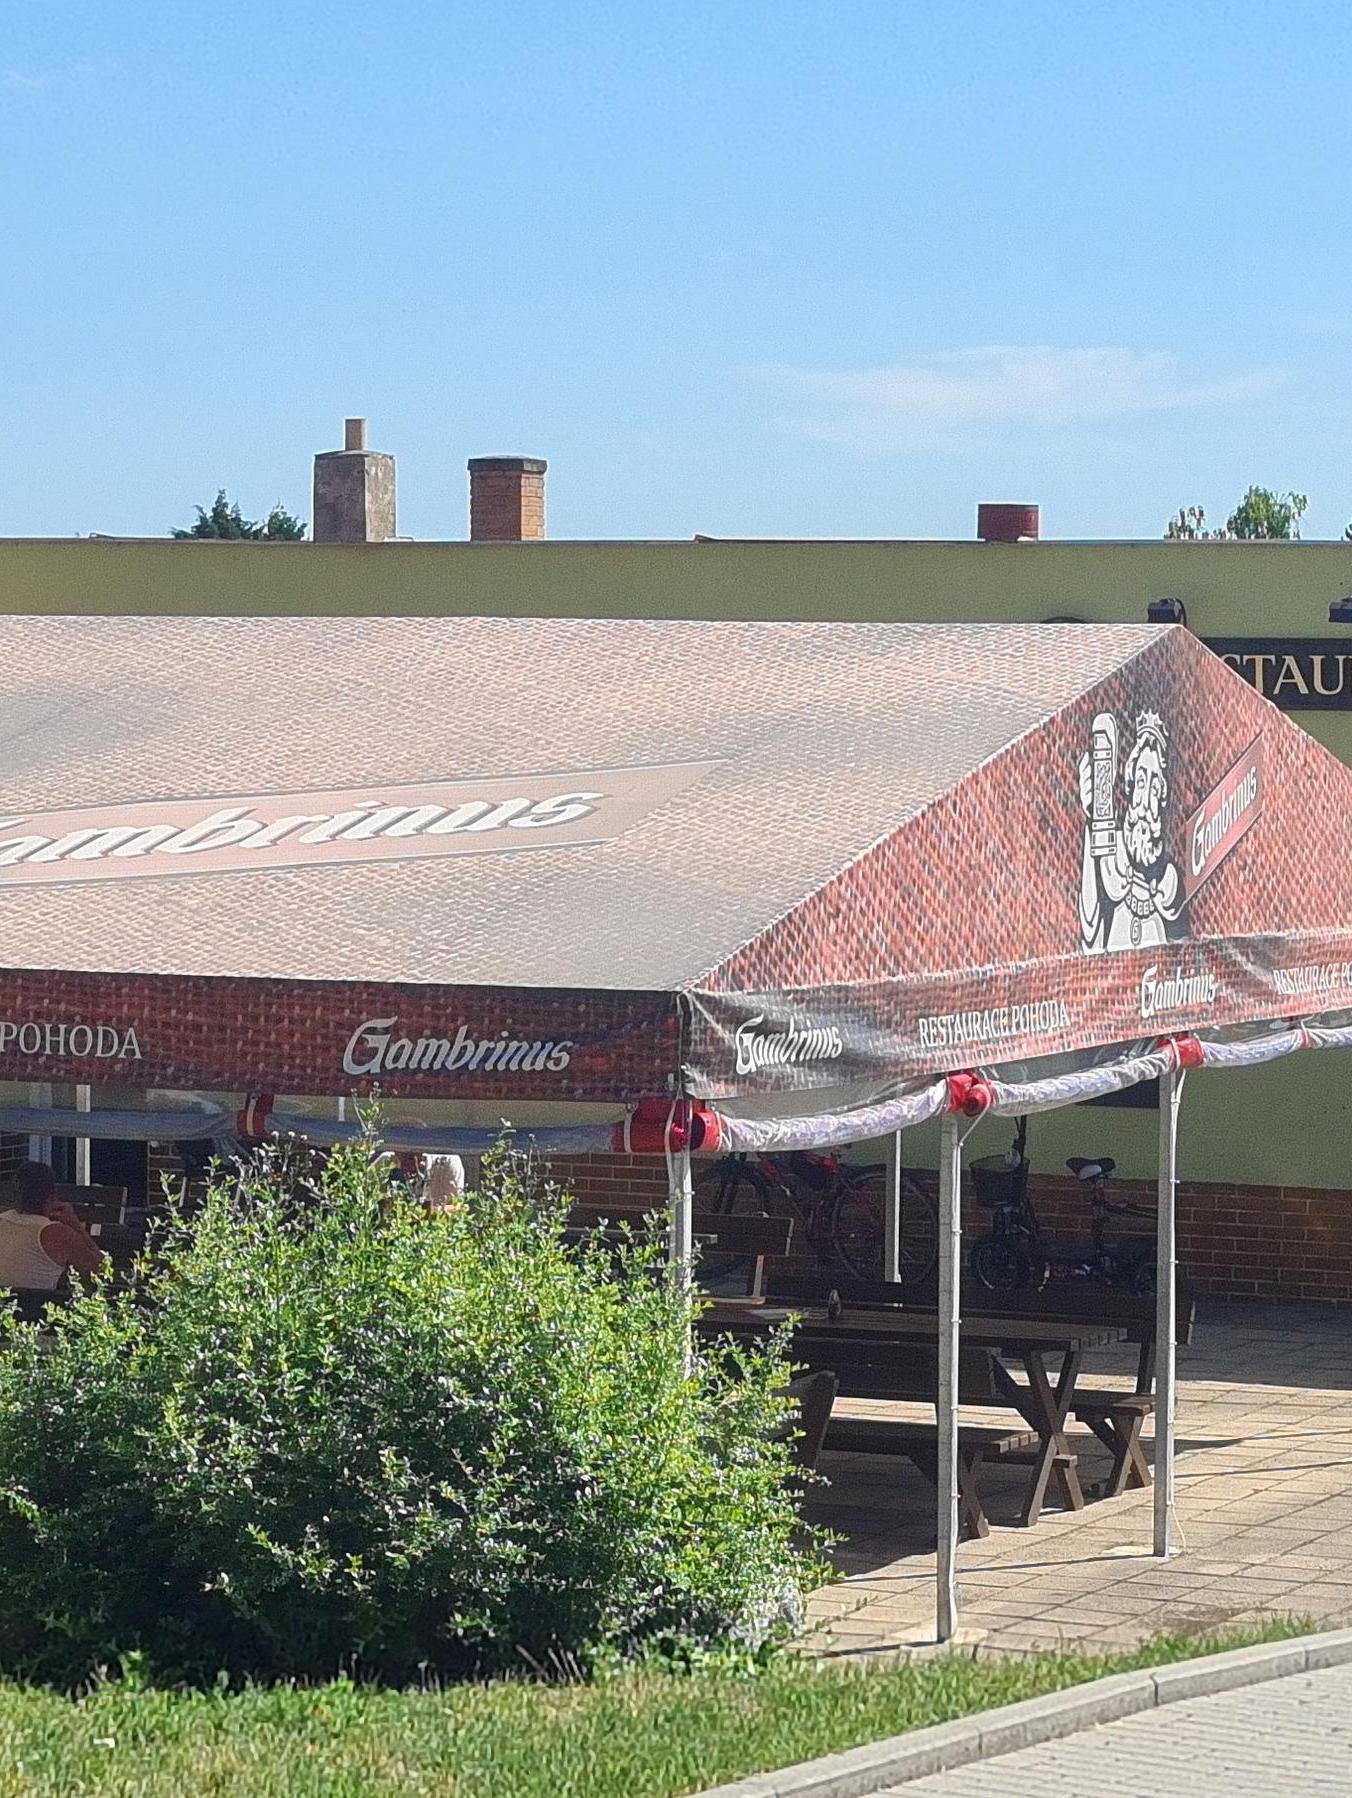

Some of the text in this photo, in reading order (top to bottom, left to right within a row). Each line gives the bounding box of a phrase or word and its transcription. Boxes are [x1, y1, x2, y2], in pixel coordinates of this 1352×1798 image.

[0, 791, 608, 867] ambrinus
[1191, 766, 1257, 876] Gambrinus
[1141, 964, 1216, 1018] Gambrinus
[1273, 964, 1340, 995] RESTAURACE
[0, 1022, 143, 1060] POHODA
[342, 1016, 574, 1075] Gambrinus
[736, 1014, 842, 1075] Gambrinus
[919, 999, 1071, 1048] RESTAURACE POHODA
